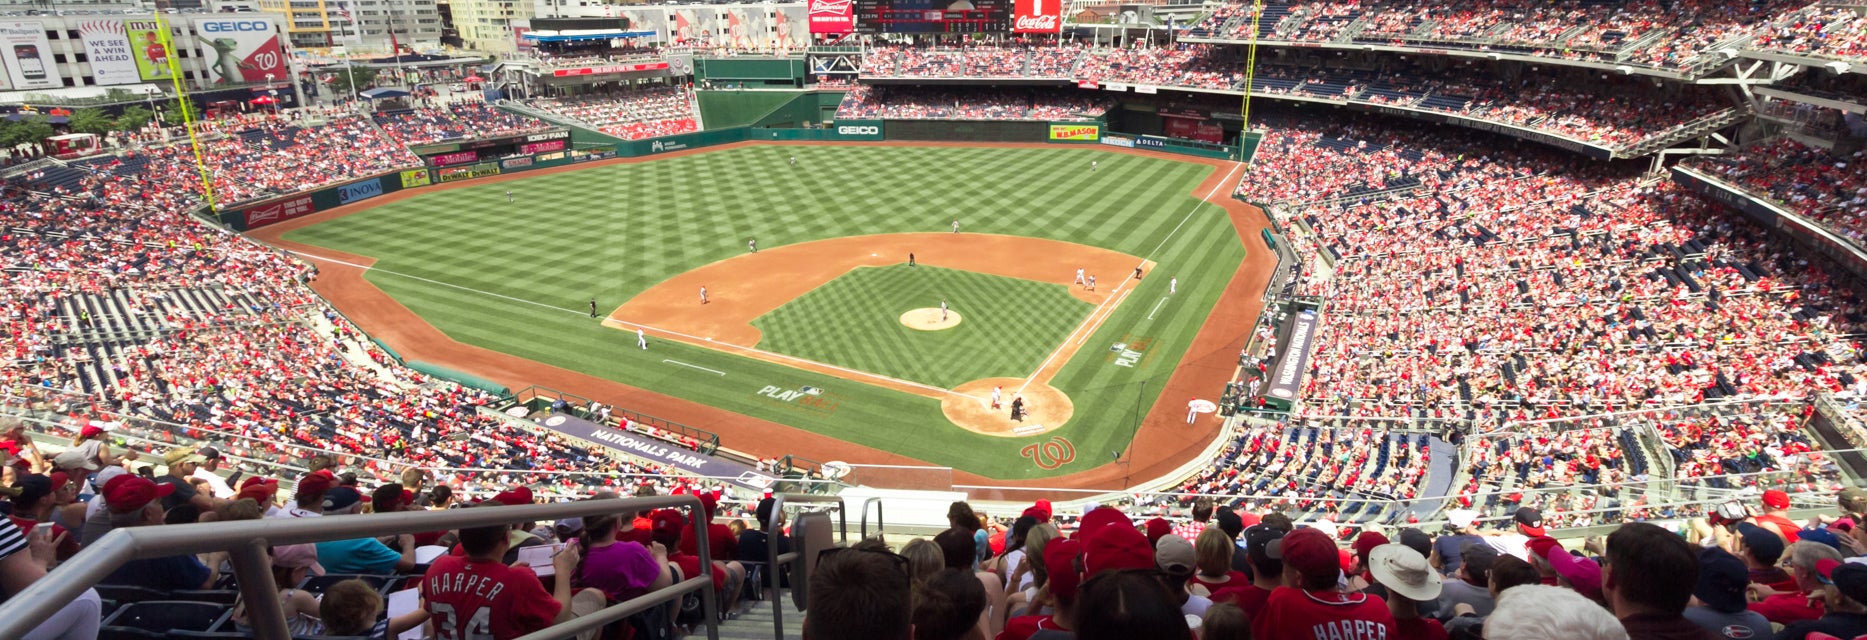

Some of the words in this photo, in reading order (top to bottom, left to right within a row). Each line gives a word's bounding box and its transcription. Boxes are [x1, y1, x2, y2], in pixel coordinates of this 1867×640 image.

[203, 21, 267, 32] GEICO
[1016, 14, 1057, 29] Coca-Cola
[95, 54, 129, 62] AHEAD
[549, 131, 569, 139] FAN
[838, 126, 878, 134] GEICO
[350, 182, 381, 197] INOVA
[1114, 348, 1143, 368] PLAY
[757, 385, 805, 402] PLAY
[590, 429, 668, 457] NATIONALS
[665, 451, 708, 469] PARK
[431, 572, 505, 601] HARPER
[431, 601, 495, 640] 34
[1313, 619, 1387, 640] HARPER
